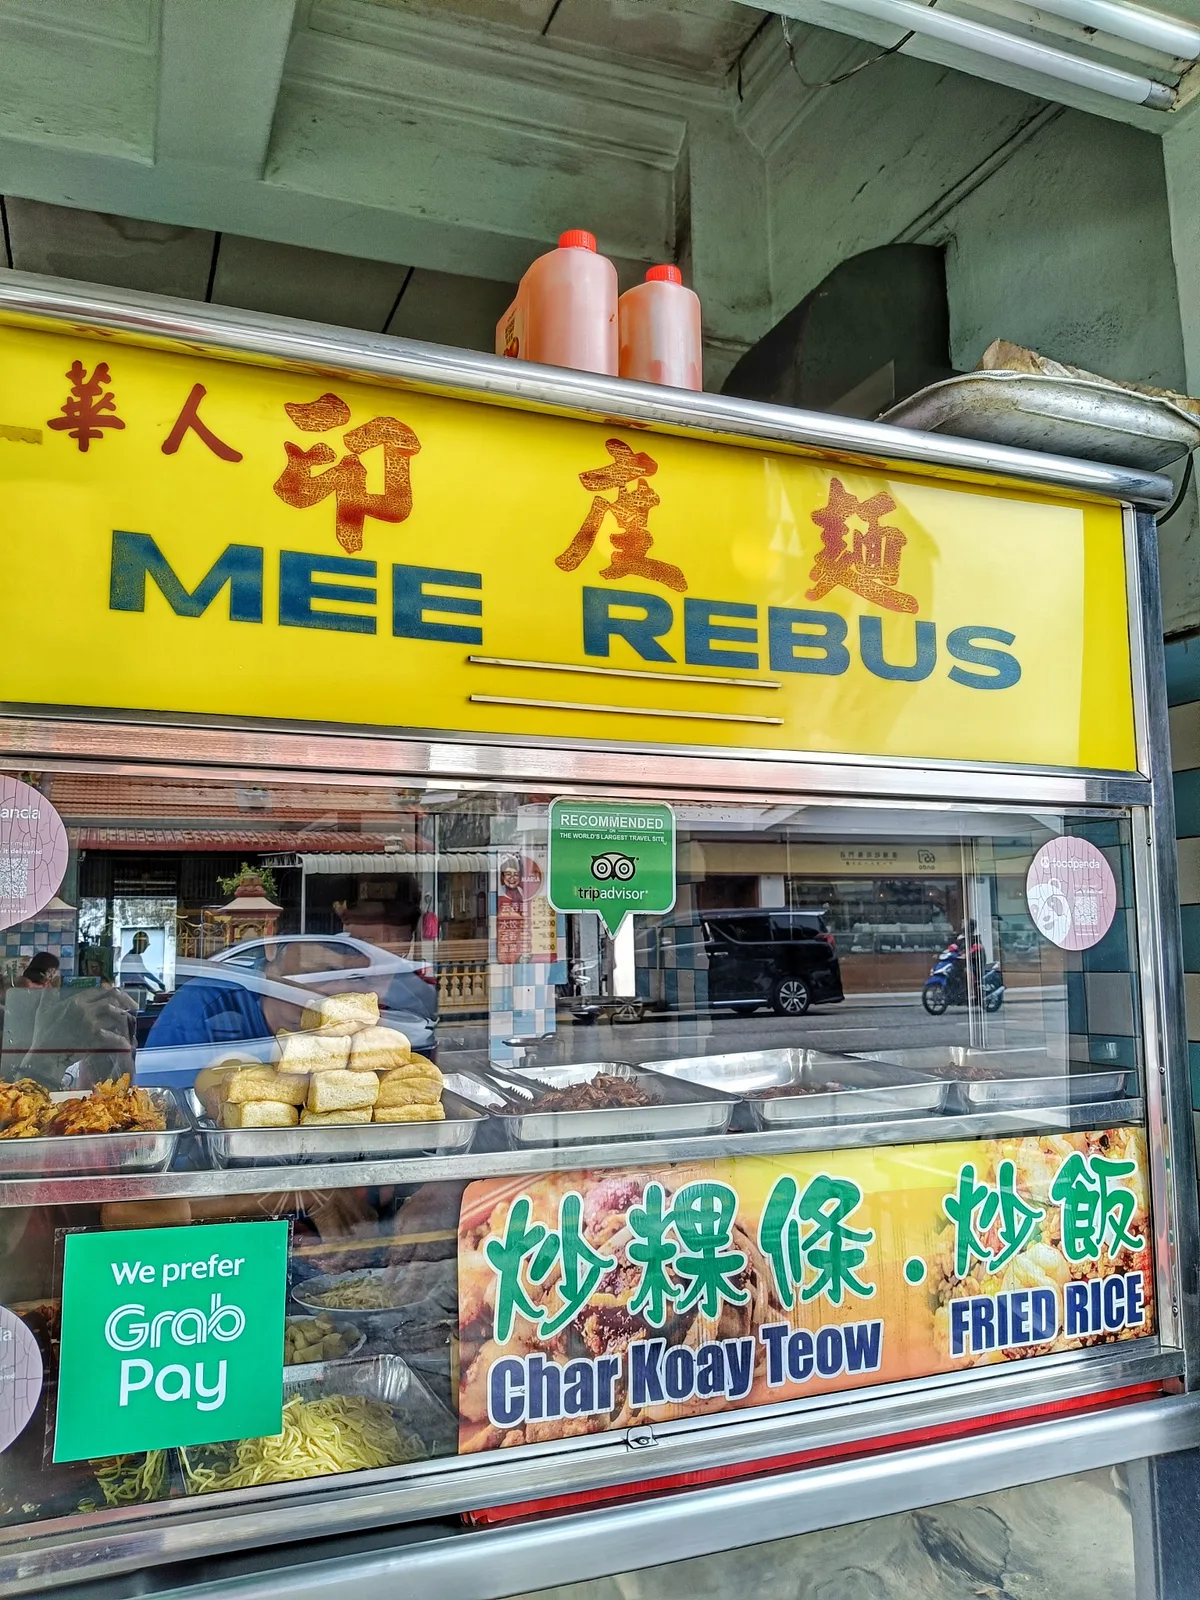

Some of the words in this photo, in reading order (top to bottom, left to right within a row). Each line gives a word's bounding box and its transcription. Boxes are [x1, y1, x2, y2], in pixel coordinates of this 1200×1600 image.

[109, 529, 483, 645] MEE
[582, 586, 1022, 690] REBUS
[560, 814, 664, 830] RECOMMENDED
[1052, 857, 1100, 870] foodpanda
[578, 886, 645, 902] tripadvisor
[111, 1260, 155, 1286] We
[161, 1253, 245, 1288] prefer
[485, 1172, 877, 1346] 炒粿條
[944, 1151, 1144, 1277] 炒飯
[104, 1293, 246, 1352] Grab
[951, 1290, 1057, 1356] FRIED
[1065, 1273, 1144, 1335] RICE
[118, 1358, 228, 1412] Pay
[490, 1352, 619, 1427] Char
[630, 1339, 753, 1401] Koay
[762, 1320, 884, 1387] Teow
